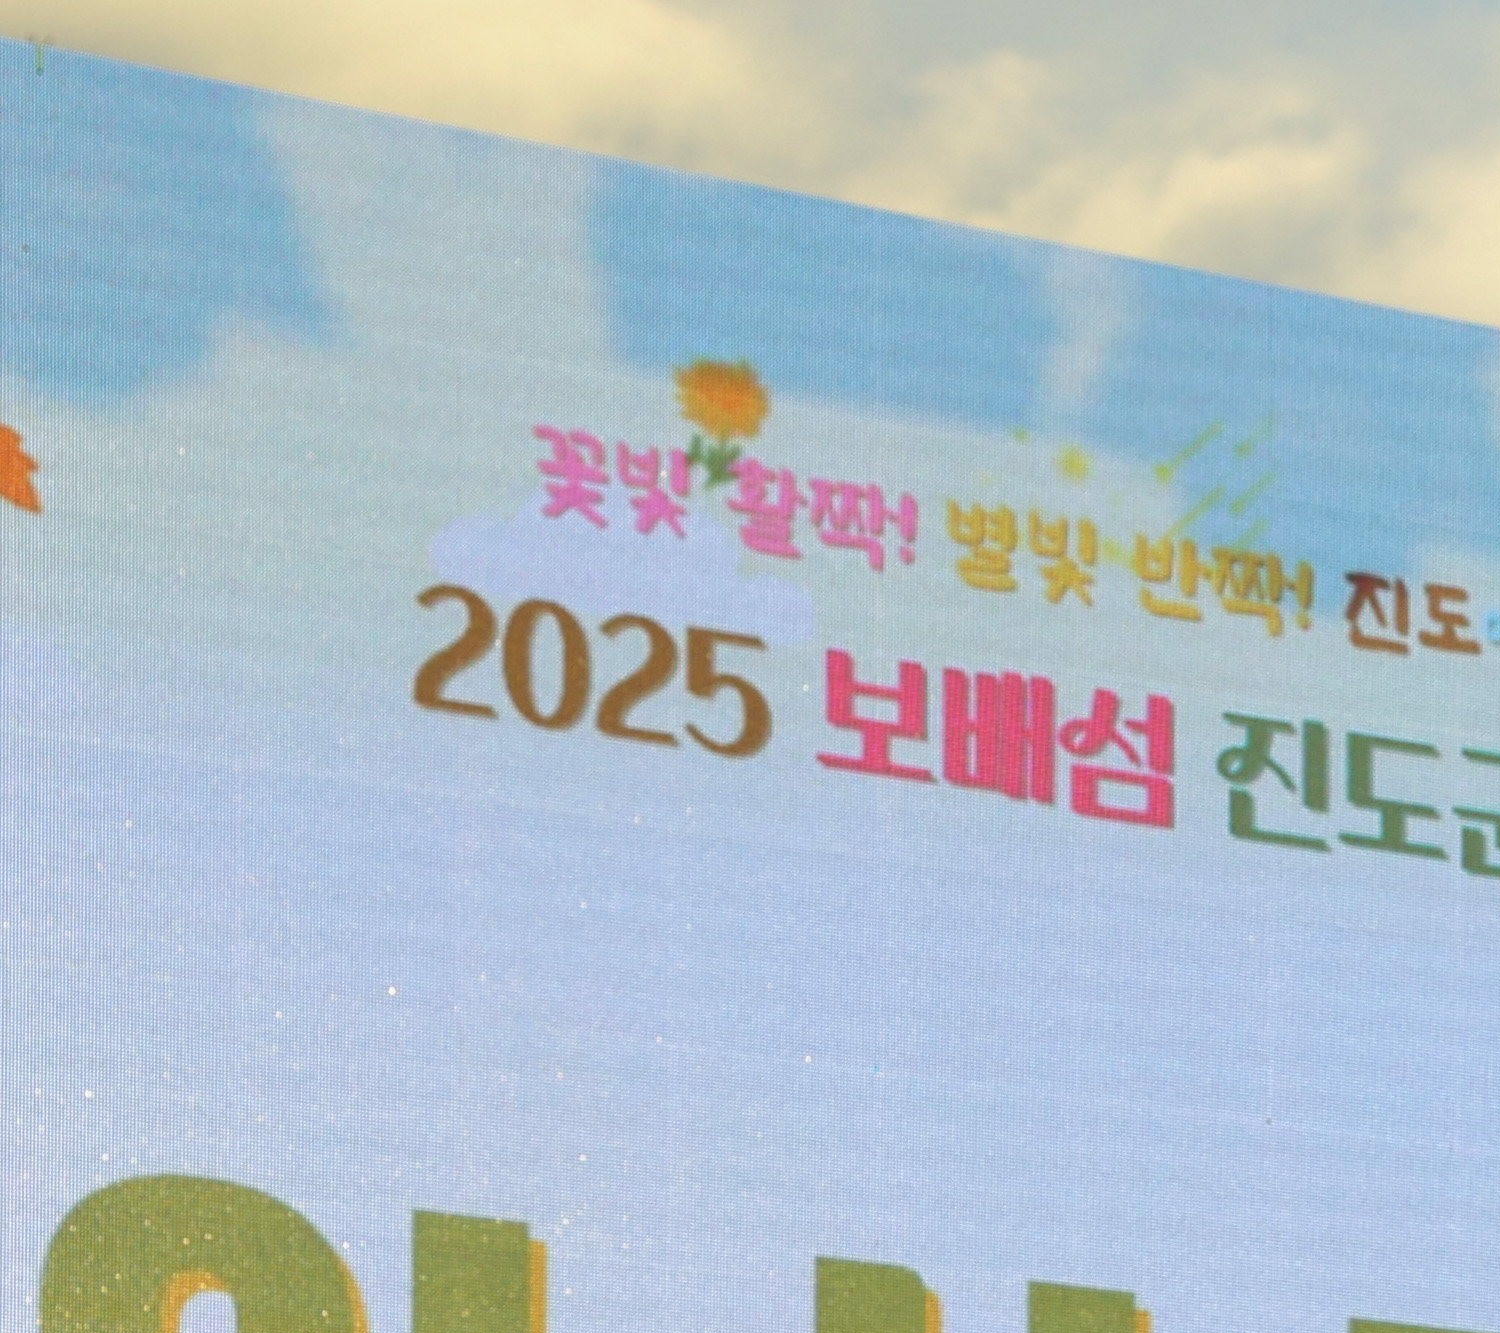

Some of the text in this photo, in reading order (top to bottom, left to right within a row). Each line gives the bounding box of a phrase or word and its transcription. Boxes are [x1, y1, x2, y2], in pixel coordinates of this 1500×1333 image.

[532, 424, 692, 538] 꽃빛
[727, 455, 919, 571] 활짝!
[946, 498, 1095, 606] 별빛
[1132, 533, 1315, 638] 반짝!
[414, 582, 773, 760] 2025
[815, 648, 1176, 829] 보배섬
